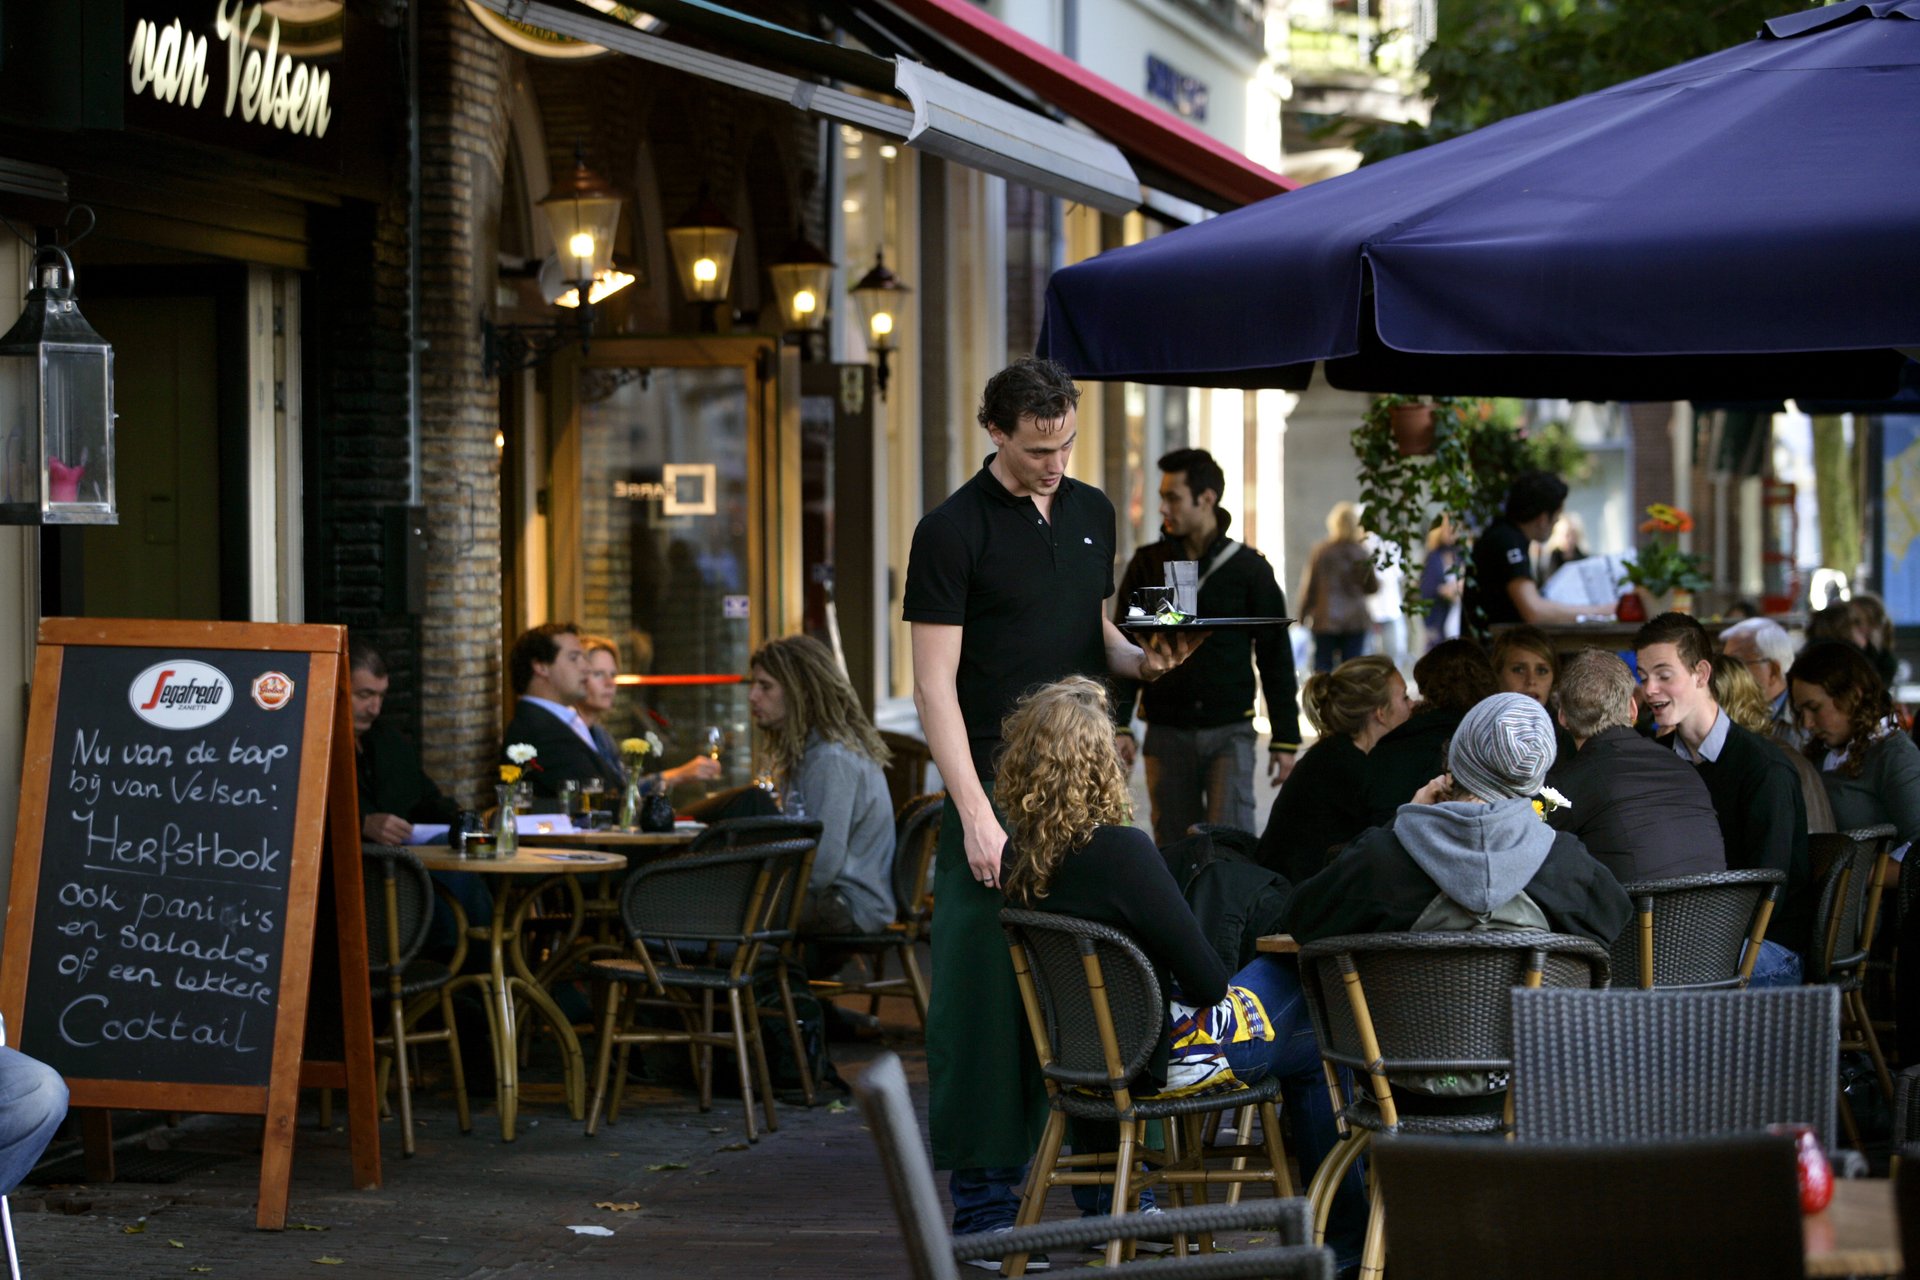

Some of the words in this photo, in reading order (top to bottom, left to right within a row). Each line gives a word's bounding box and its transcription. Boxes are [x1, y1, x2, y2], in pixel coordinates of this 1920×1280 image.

[129, 17, 209, 109] van
[216, 0, 332, 139] Velsen
[140, 669, 223, 709] Segafredo
[71, 728, 111, 766] Nu
[122, 743, 174, 767] van
[185, 740, 220, 765] de
[228, 737, 289, 774] tap
[68, 769, 101, 805] bij
[112, 778, 163, 798] van
[71, 810, 280, 876] Herfstbok
[57, 920, 107, 940] en
[108, 963, 162, 988] een
[175, 966, 272, 1005] lekkere
[58, 993, 258, 1052] Cocktail
